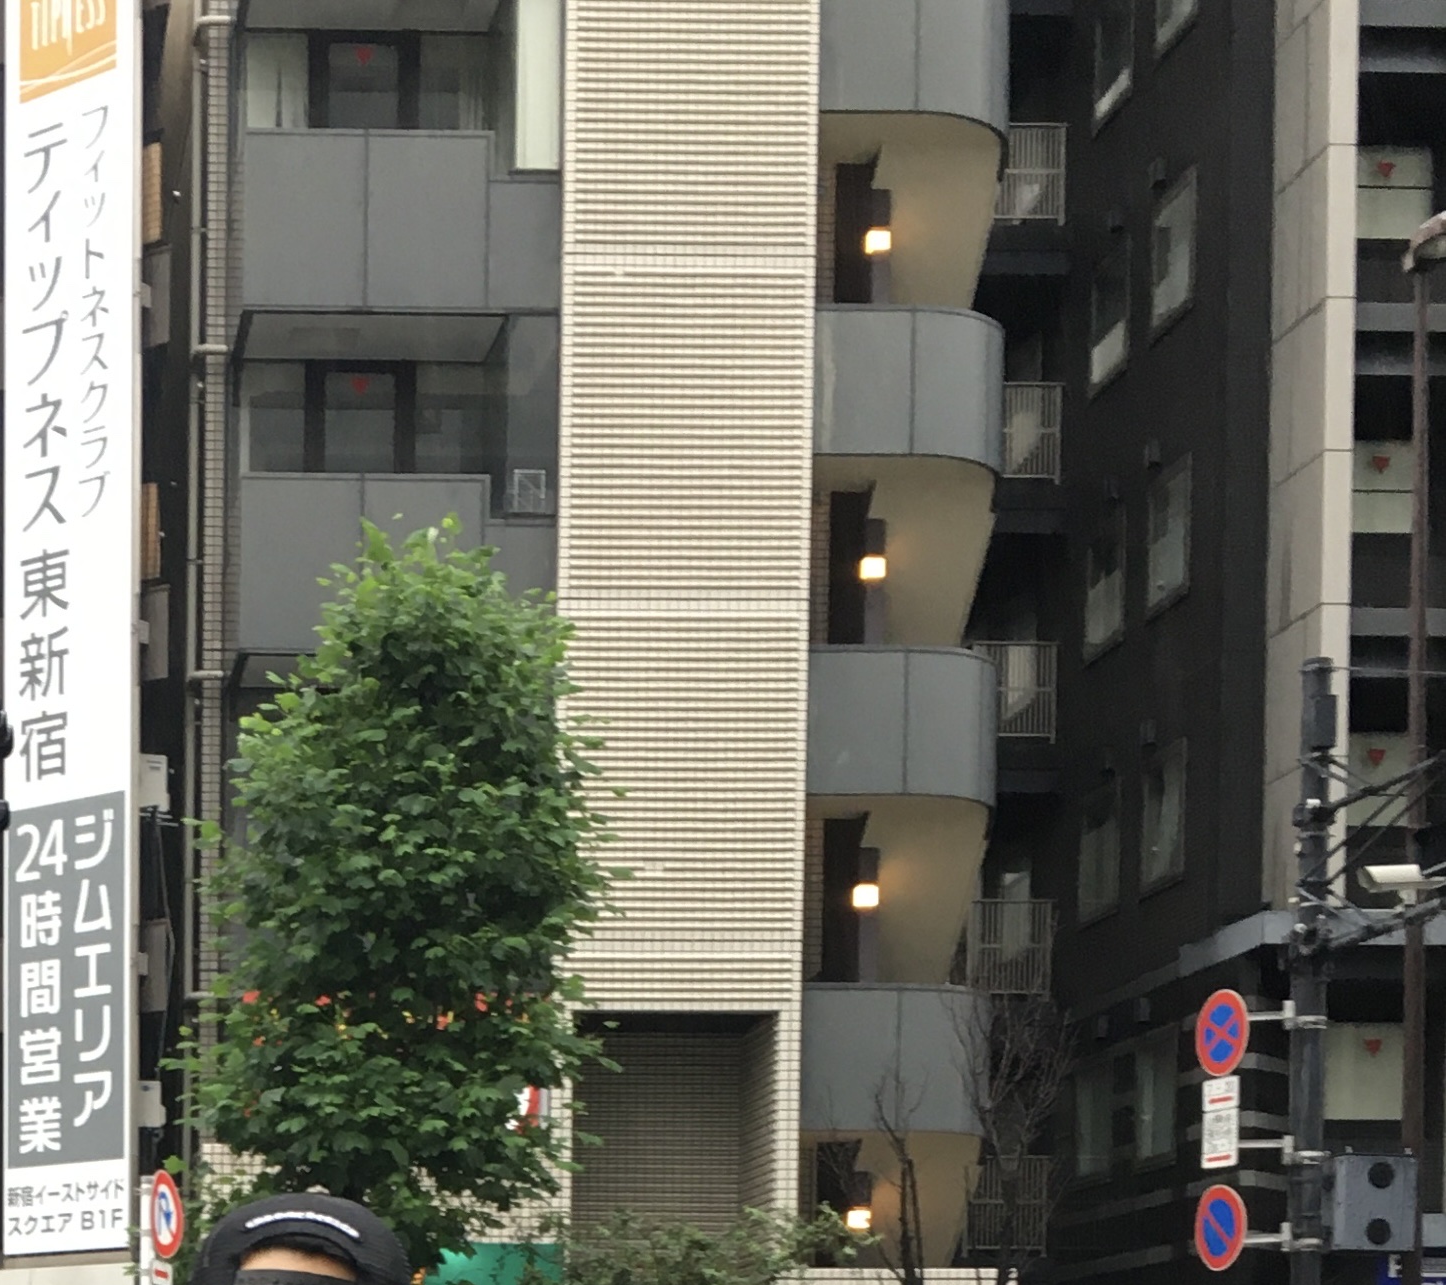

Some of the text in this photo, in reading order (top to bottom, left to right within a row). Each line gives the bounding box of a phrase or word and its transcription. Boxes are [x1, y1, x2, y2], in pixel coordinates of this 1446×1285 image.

[79, 105, 110, 518] フィットネスクラブ
[15, 818, 68, 1154] 24時間営業
[74, 808, 115, 1127] ジムエリア
[7, 1179, 125, 1208] 新宿イーストサイド
[7, 1208, 123, 1236] スクエア B1F
